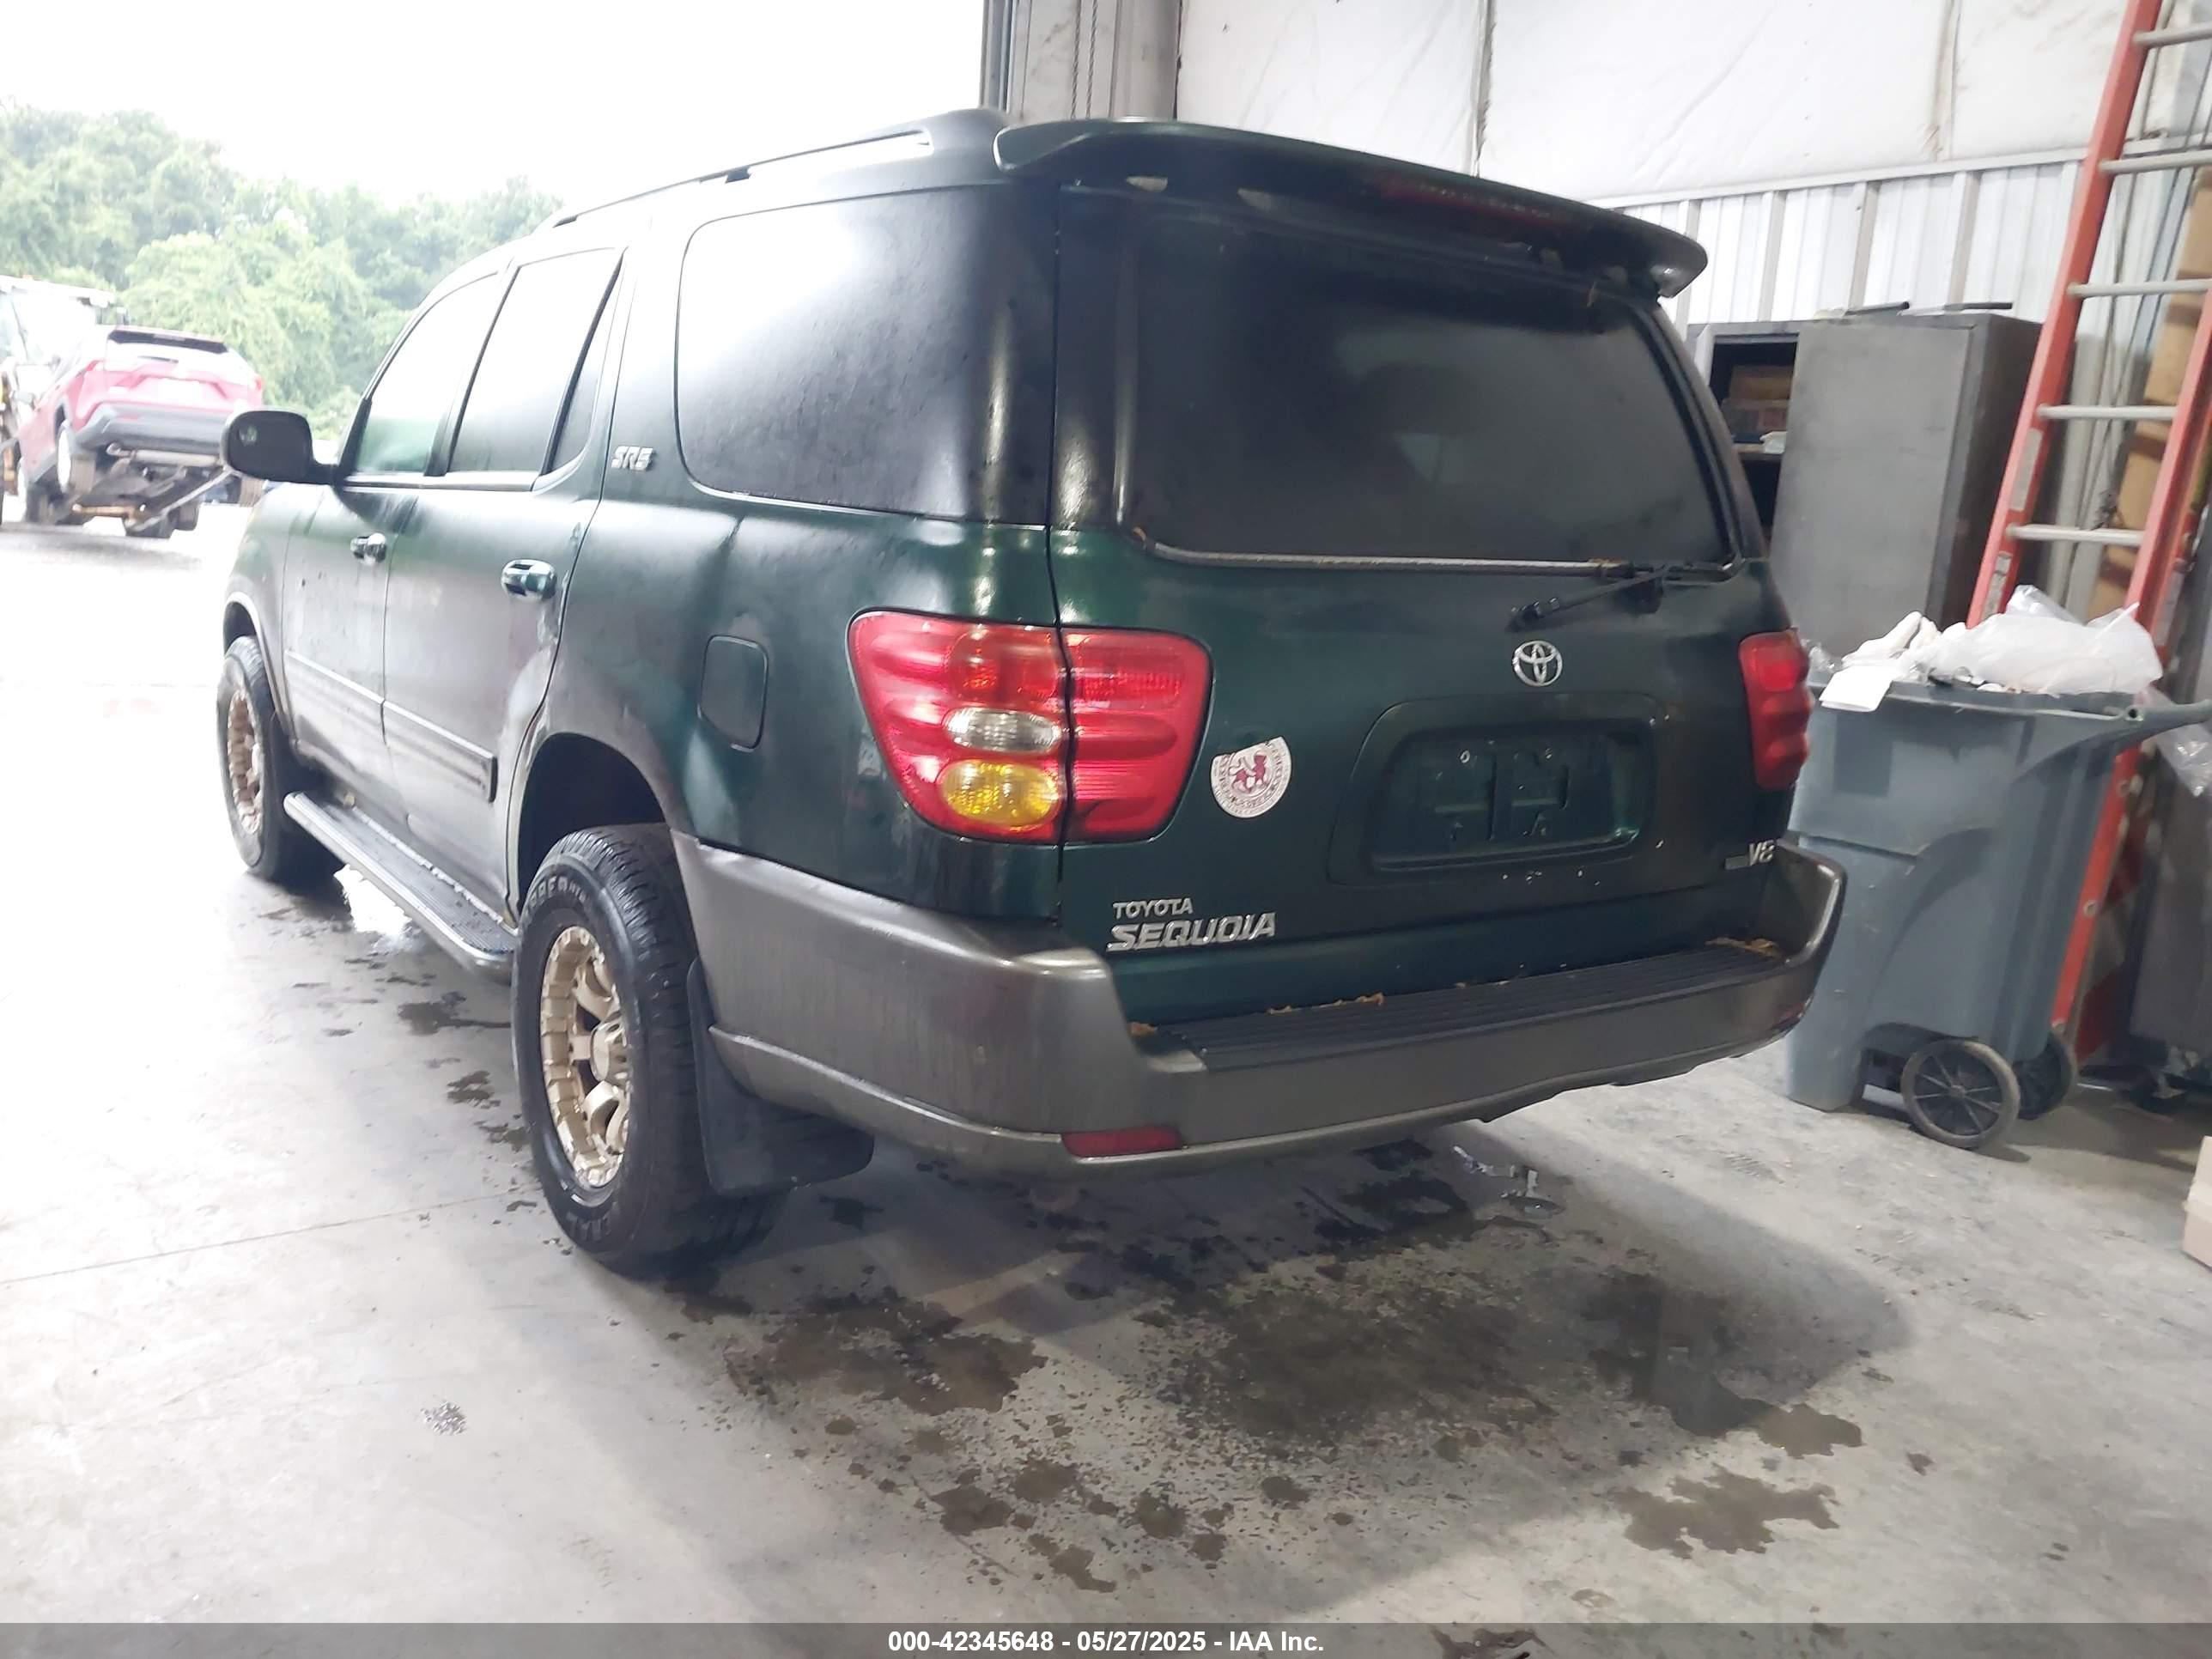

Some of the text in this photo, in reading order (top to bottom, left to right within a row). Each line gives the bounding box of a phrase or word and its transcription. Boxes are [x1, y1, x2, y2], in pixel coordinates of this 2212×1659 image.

[611, 446, 653, 471] SR5
[1749, 840, 1775, 866] V8
[1113, 897, 1194, 919] TOYOTA
[1106, 912, 1277, 952] SEQUOIA
